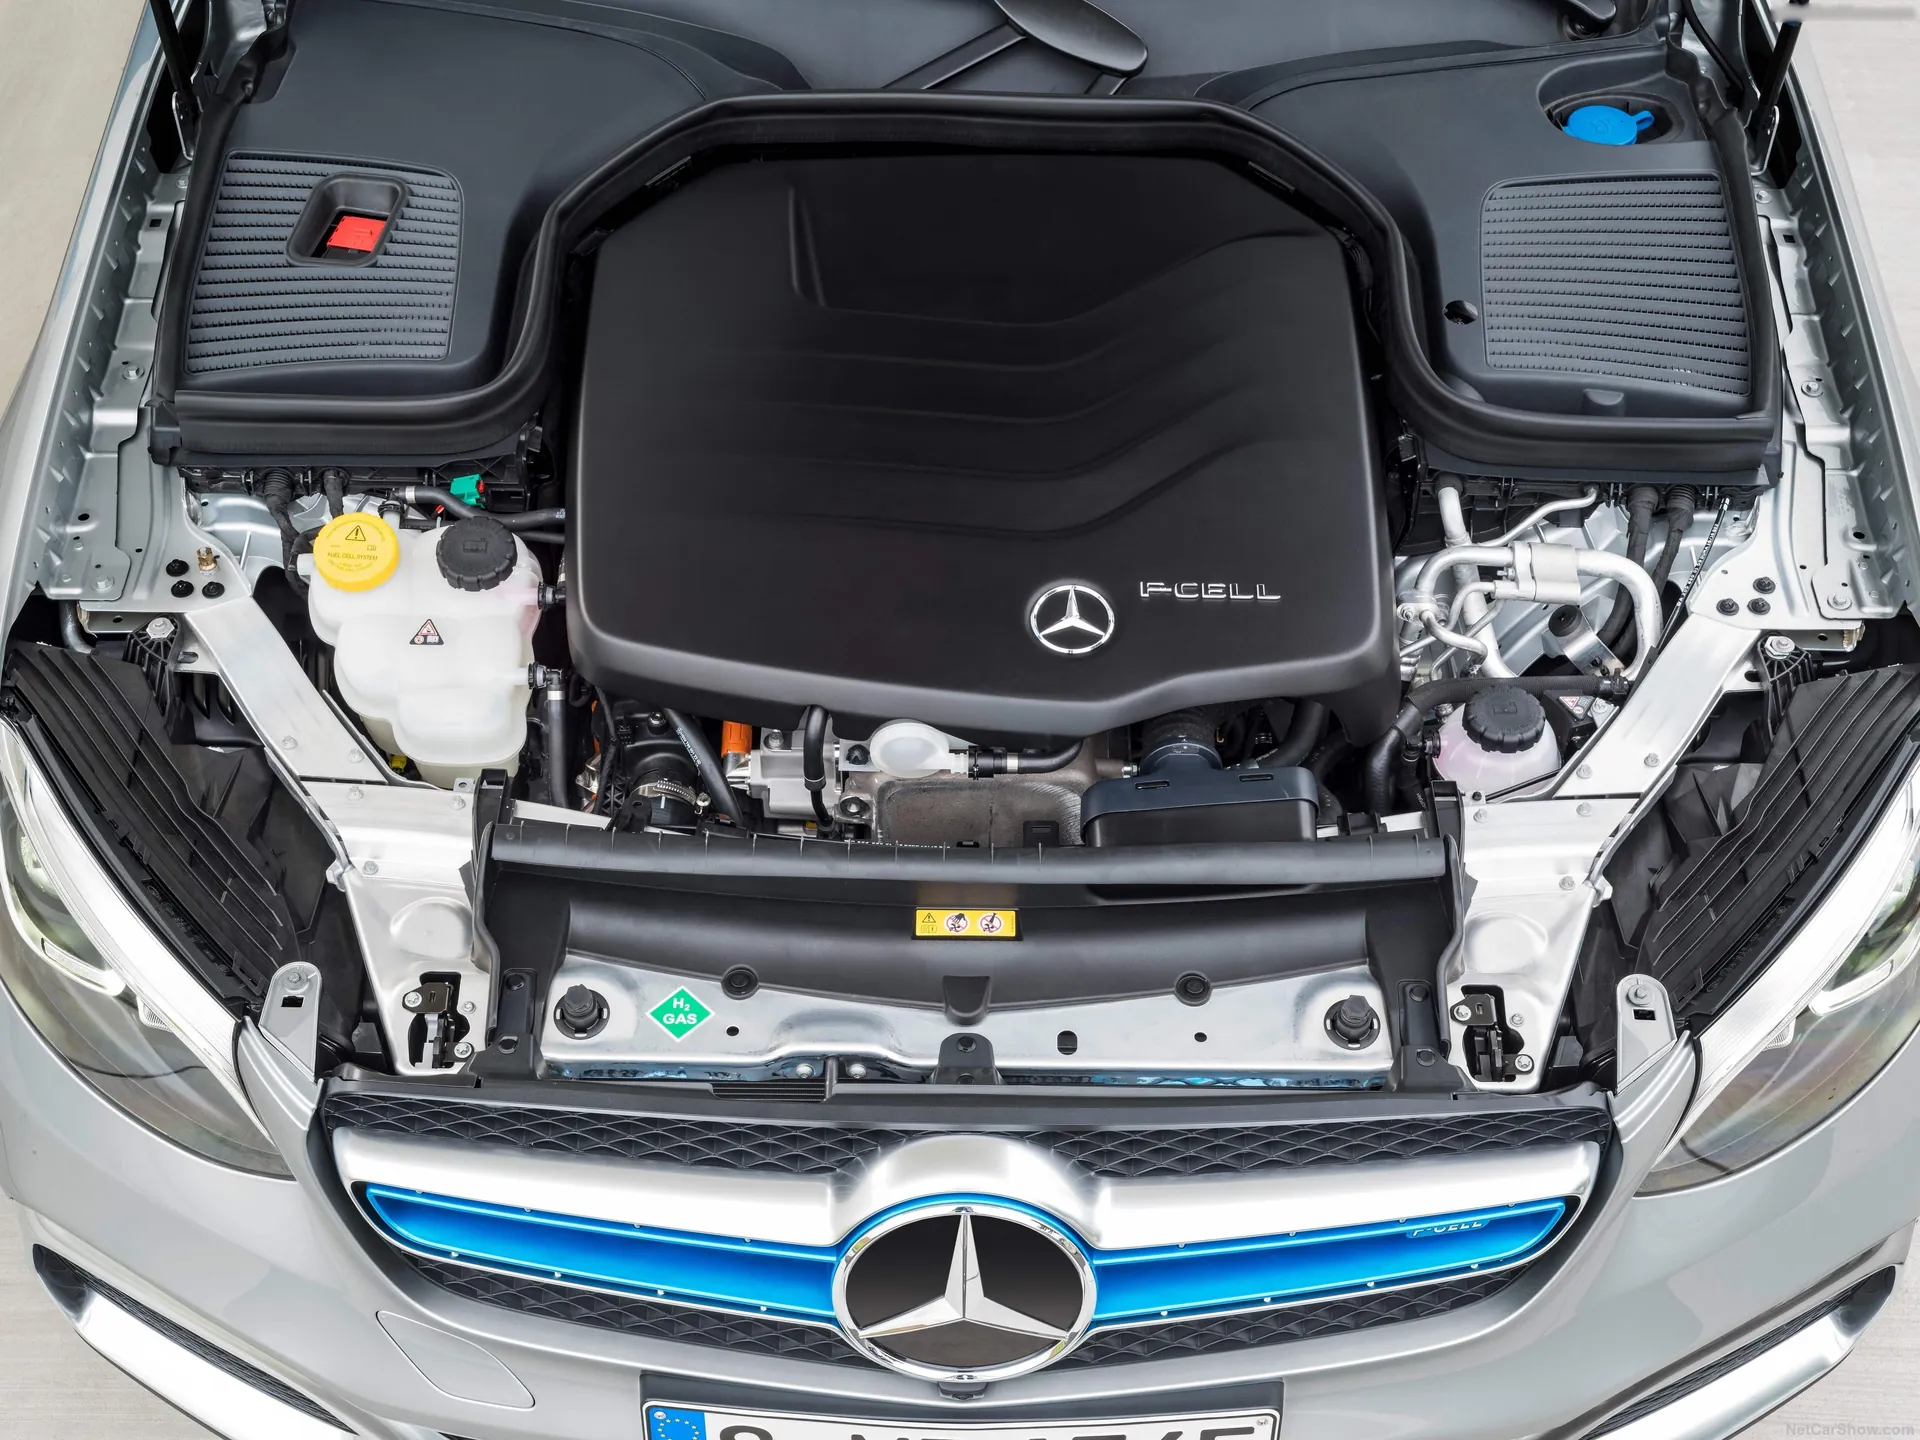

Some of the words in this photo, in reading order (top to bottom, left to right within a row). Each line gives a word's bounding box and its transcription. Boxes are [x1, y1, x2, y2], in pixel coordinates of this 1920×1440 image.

[341, 552, 355, 560] CELL
[356, 553, 378, 561] SYSTEM
[1139, 580, 1281, 601] F-CELL
[662, 1012, 698, 1025] GAS
